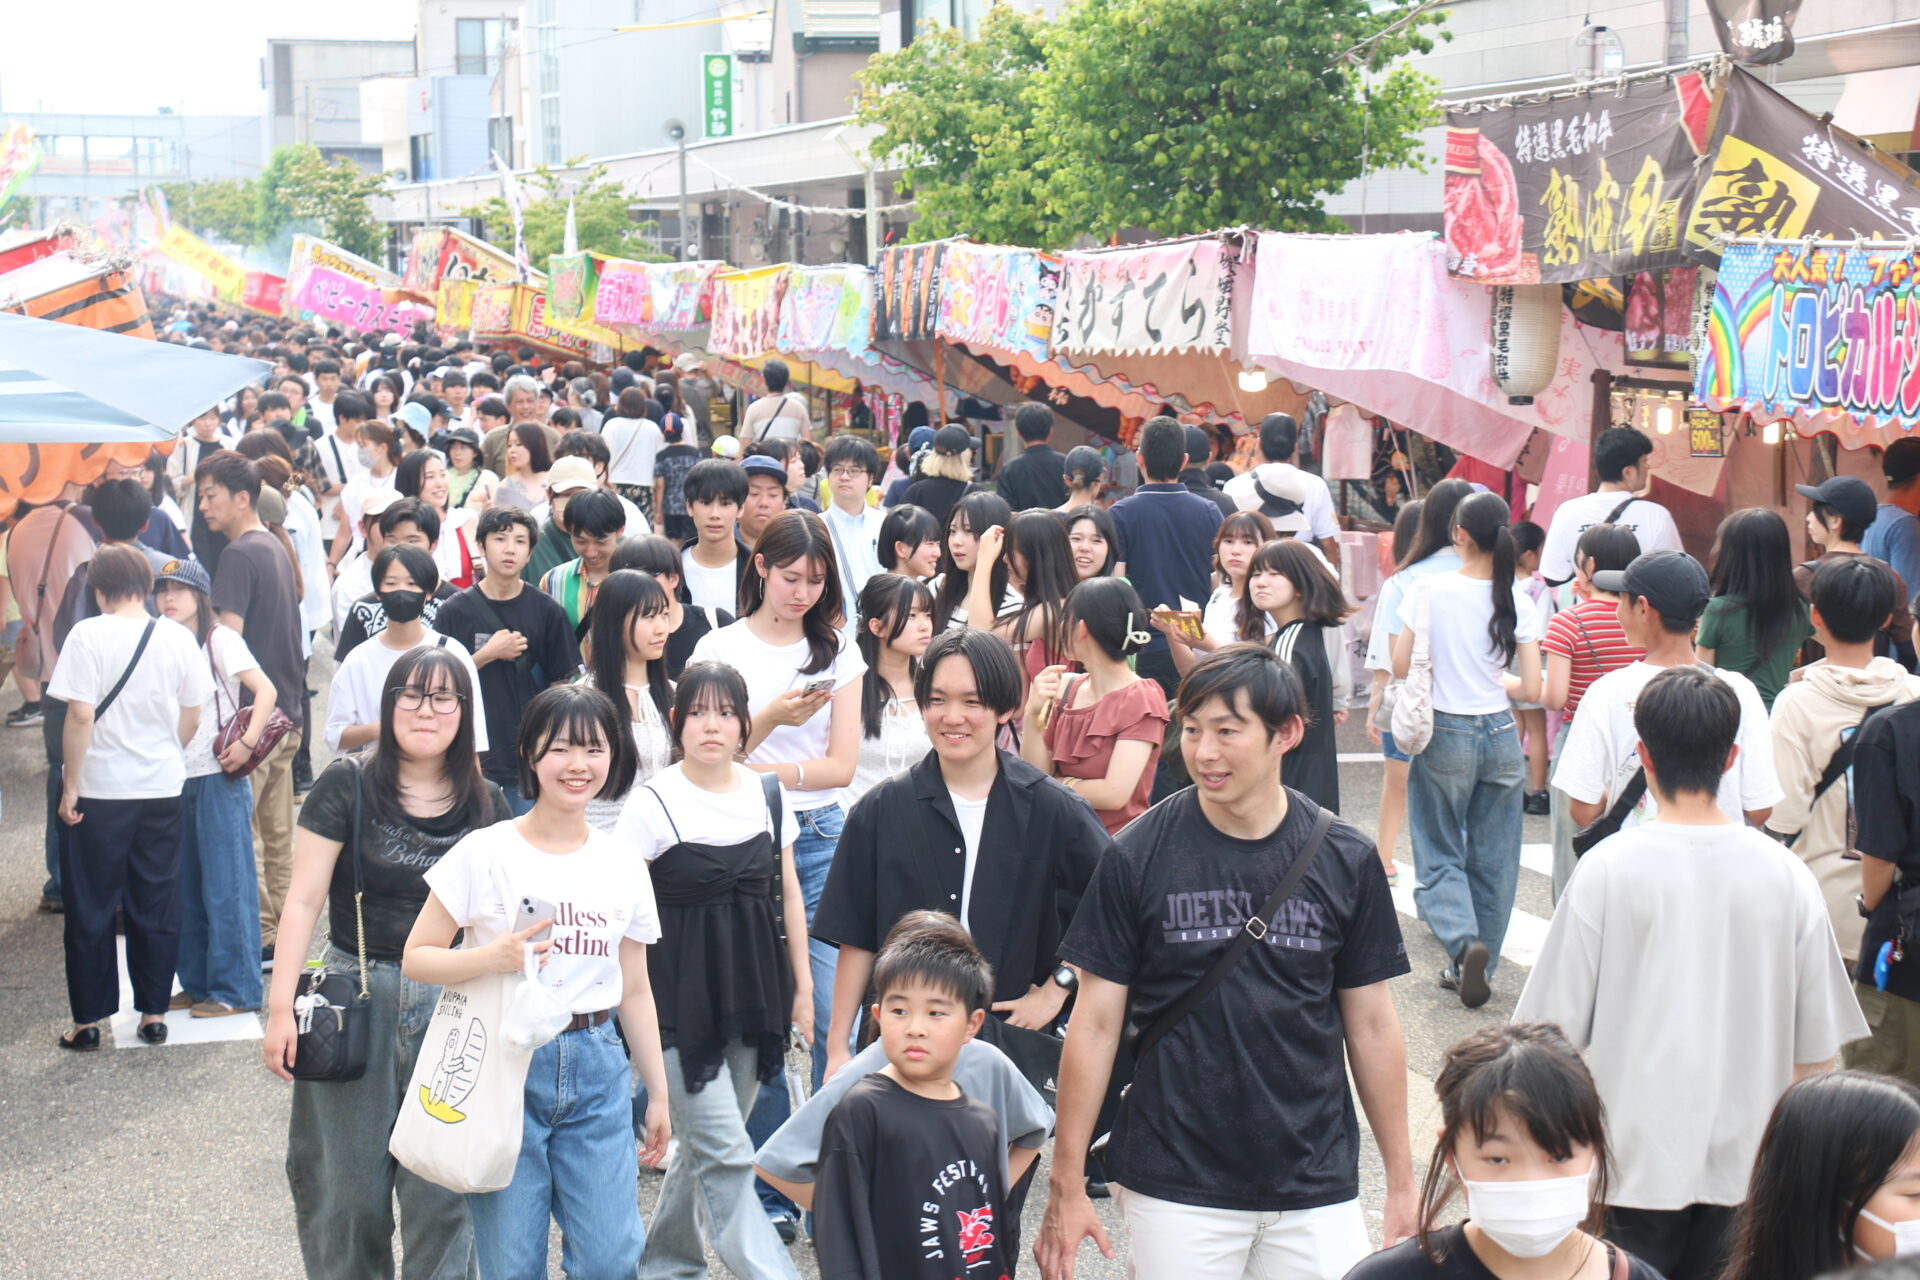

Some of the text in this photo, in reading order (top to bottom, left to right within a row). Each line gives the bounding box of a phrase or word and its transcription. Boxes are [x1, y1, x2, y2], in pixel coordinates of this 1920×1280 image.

[381, 838, 442, 868] Beha
[554, 902, 607, 929] dless
[1265, 896, 1324, 938] AWS
[1181, 928, 1305, 949] BASKALL
[920, 1201, 944, 1259] JAWS
